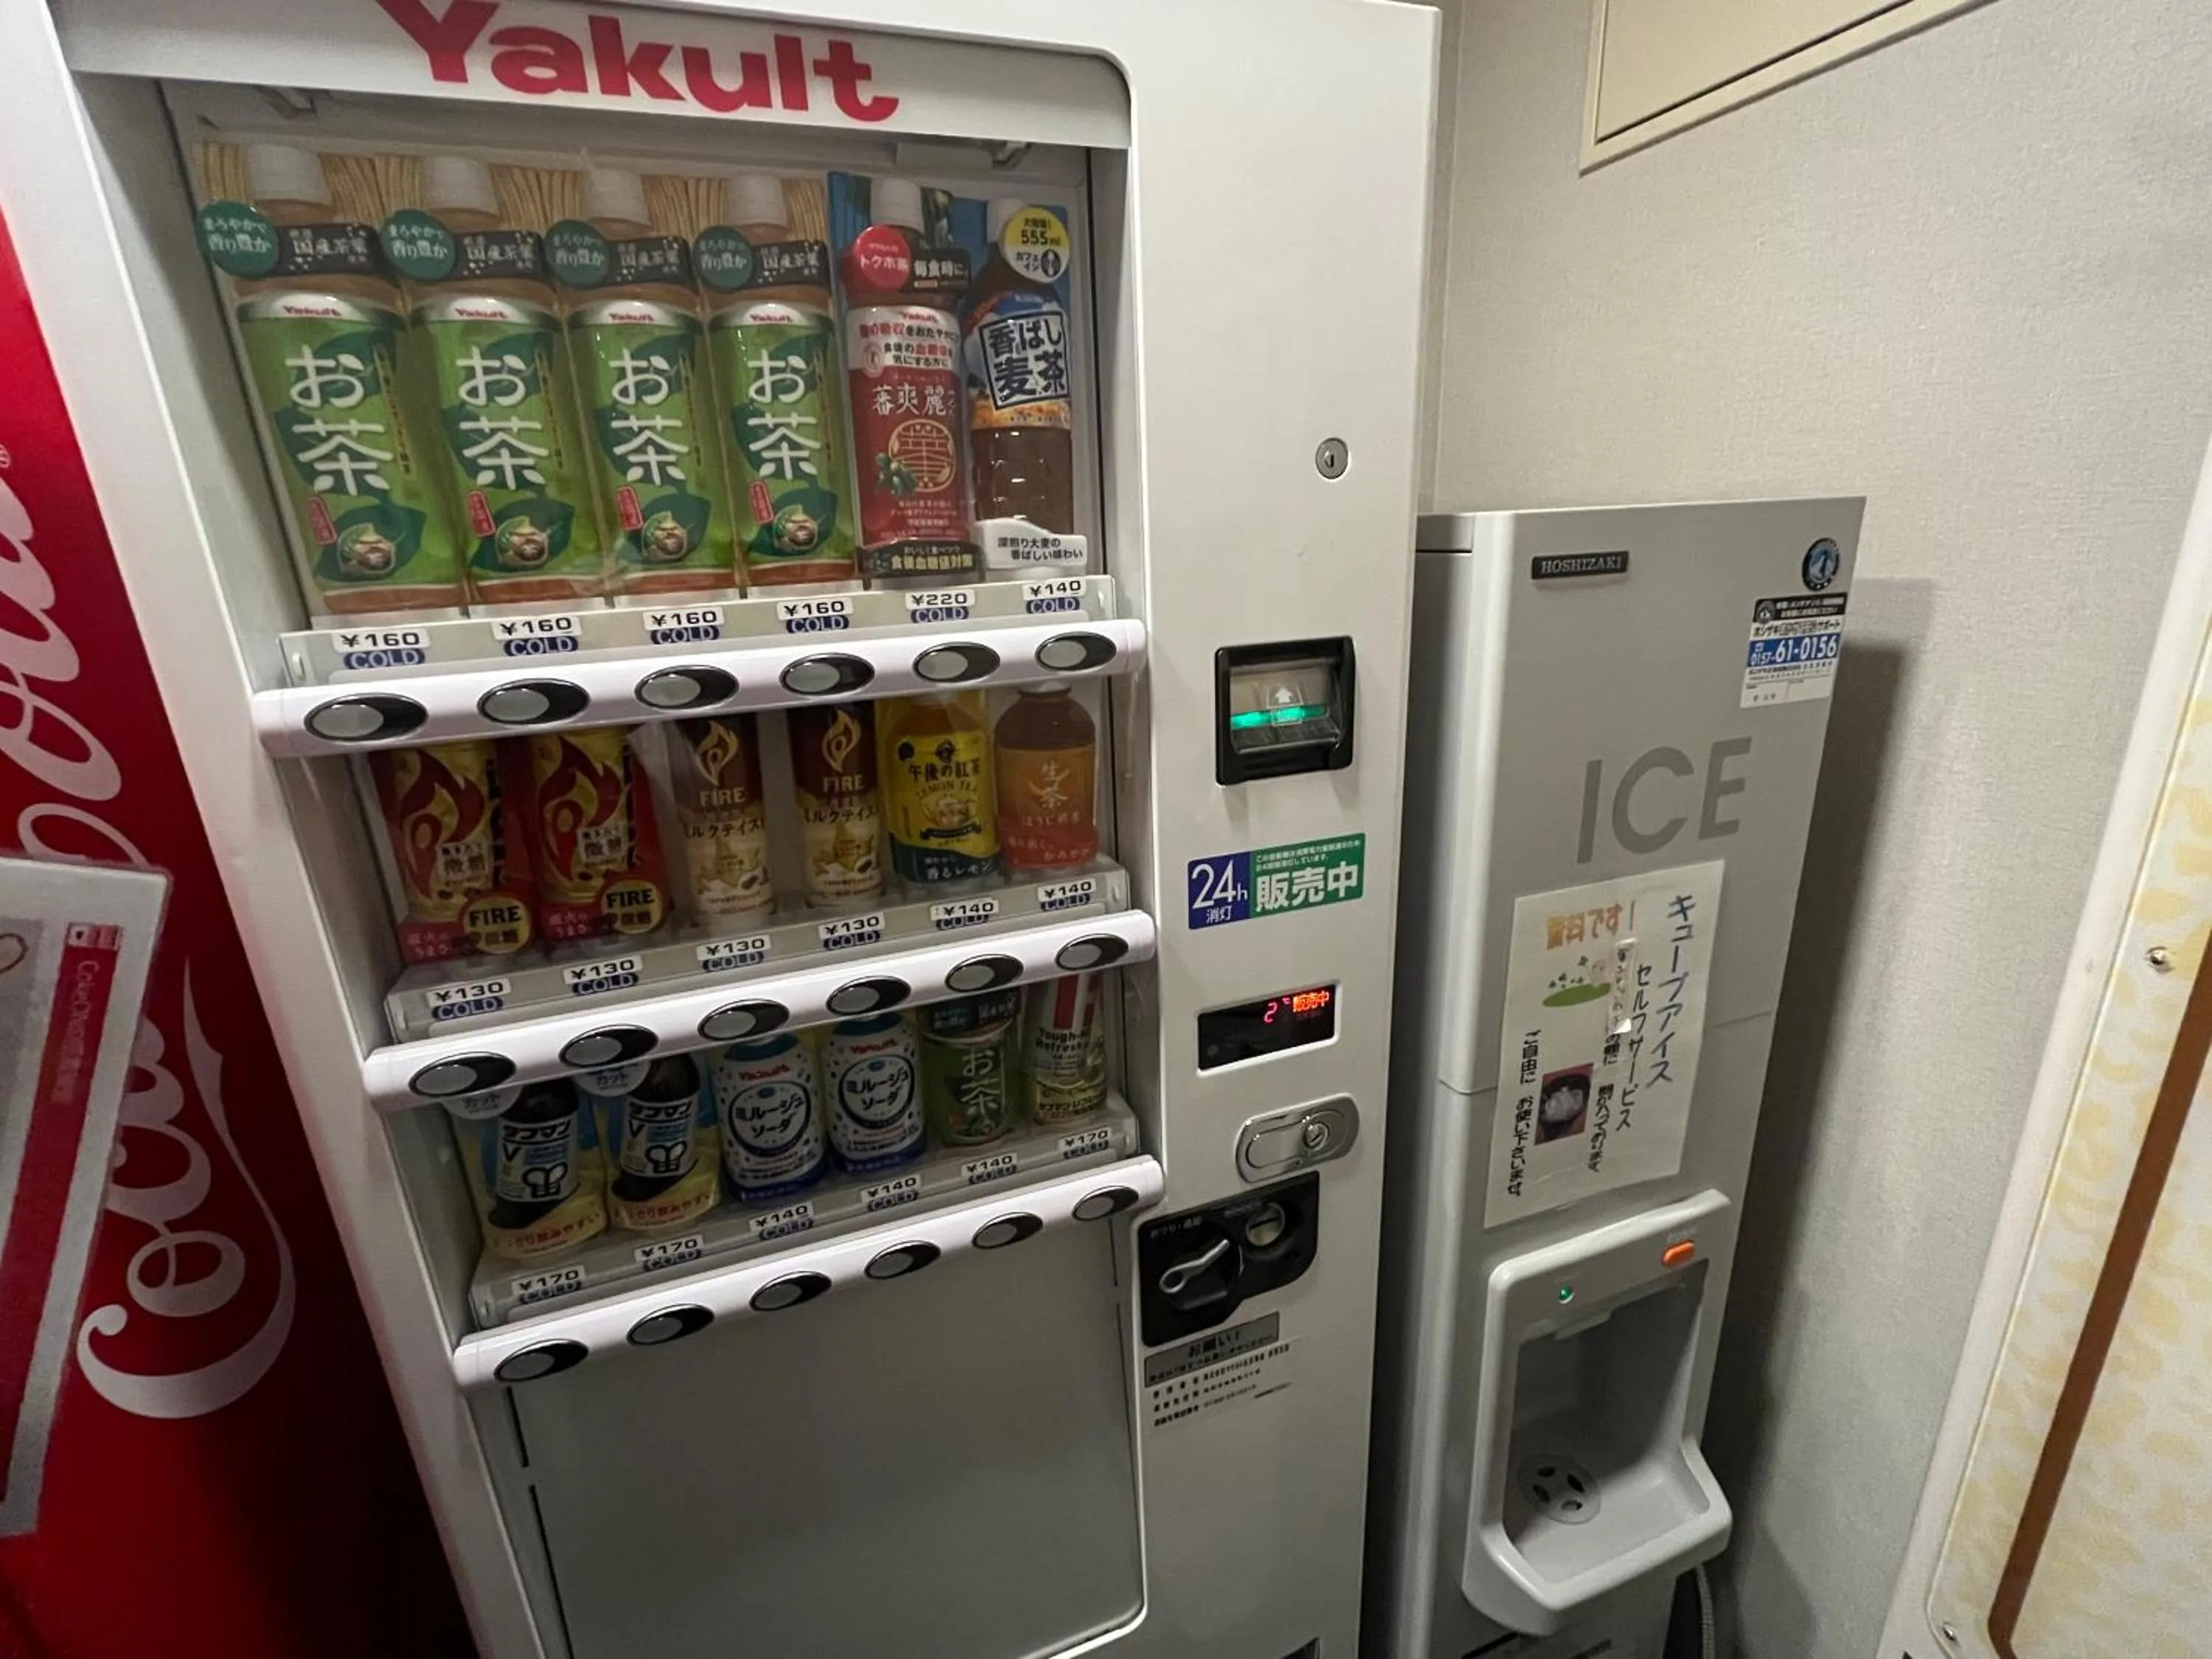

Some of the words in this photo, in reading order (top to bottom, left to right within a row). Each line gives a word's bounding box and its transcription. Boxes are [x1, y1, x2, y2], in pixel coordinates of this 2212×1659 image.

[381, 0, 900, 122] Yakult
[285, 345, 393, 496] お茶
[455, 345, 549, 491] お茶
[608, 348, 689, 486] お茶
[747, 348, 821, 480] お茶
[1541, 555, 1623, 574] HOSHIZAKI
[1030, 580, 1081, 597] ¥140
[784, 601, 844, 616] ¥160
[911, 593, 967, 605] ¥220
[499, 617, 572, 636] ¥160
[652, 611, 717, 627] ¥160
[340, 632, 420, 648] ¥160
[822, 776, 863, 792] FIRE
[700, 787, 745, 806] FIRE
[1576, 737, 1752, 863] ICE
[1044, 882, 1091, 898] ¥140
[1192, 860, 1248, 909] 24h
[1256, 860, 1359, 913] 販売中
[606, 888, 655, 908] FIRE
[469, 906, 521, 927] FIRE
[943, 902, 993, 917] ¥140
[1206, 905, 1233, 924] 消灯
[825, 917, 880, 935] ¥130
[705, 937, 764, 956] ¥130
[571, 960, 634, 979] ¥130
[434, 982, 504, 1001] ¥130
[1646, 894, 1696, 1088] キューブアイス
[1264, 1002, 1278, 1023] 2
[1616, 964, 1652, 1132] セルフサービス
[961, 1048, 1001, 1117] お茶
[867, 1178, 917, 1197] ¥140
[756, 1205, 808, 1227] ¥140
[641, 1238, 698, 1258] ¥170
[519, 1270, 579, 1290] ¥170
